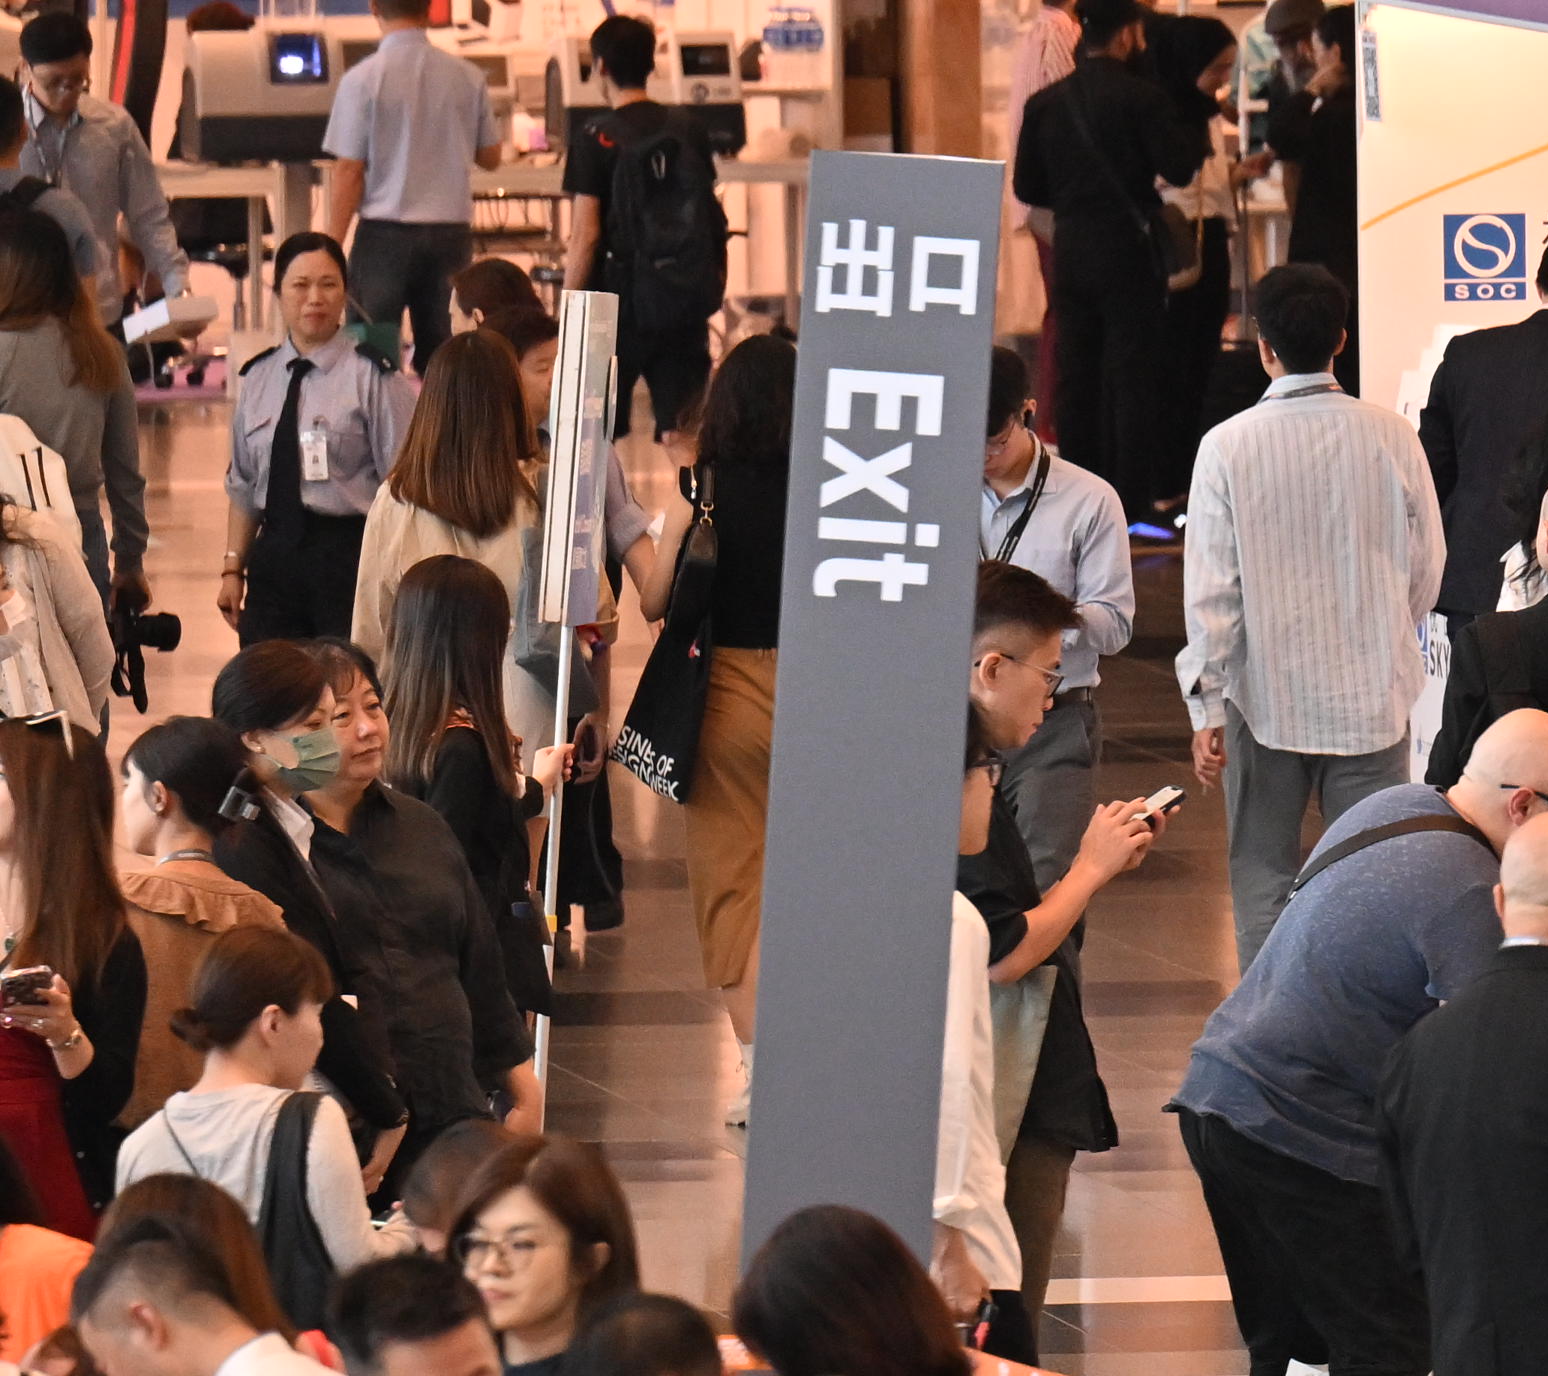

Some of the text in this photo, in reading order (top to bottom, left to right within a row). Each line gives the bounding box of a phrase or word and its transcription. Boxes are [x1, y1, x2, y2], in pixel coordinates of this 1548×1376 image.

[815, 218, 981, 317] 出口
[1453, 282, 1519, 300] SOC
[812, 367, 945, 603] Exit
[656, 754, 675, 778] OF
[650, 773, 679, 802] WEEK
